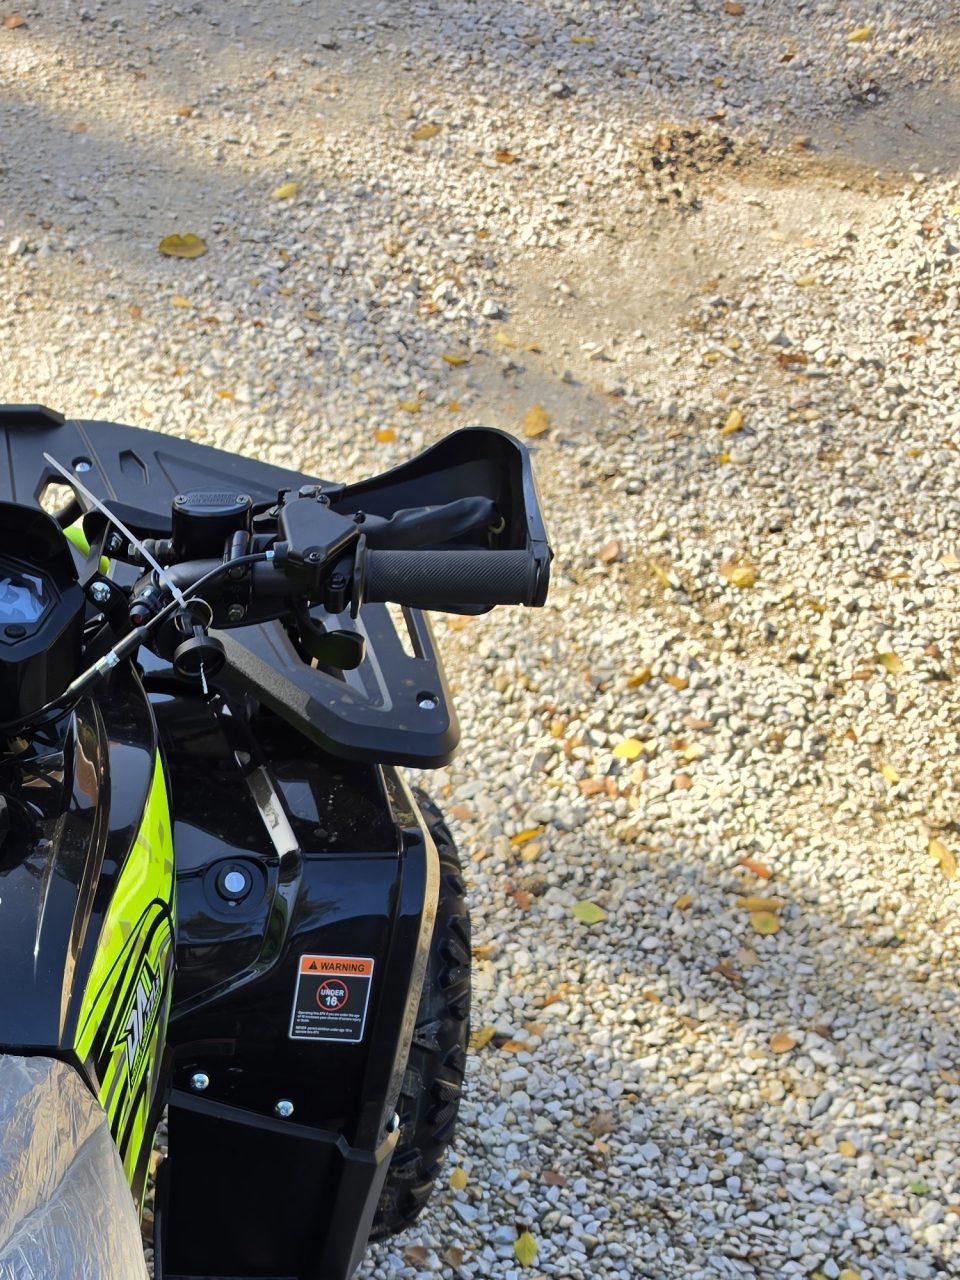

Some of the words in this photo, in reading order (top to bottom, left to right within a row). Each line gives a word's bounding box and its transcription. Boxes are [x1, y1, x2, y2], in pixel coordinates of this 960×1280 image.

[320, 962, 365, 973] WARNING
[320, 988, 345, 997] UNDER
[325, 996, 338, 1007] 16
